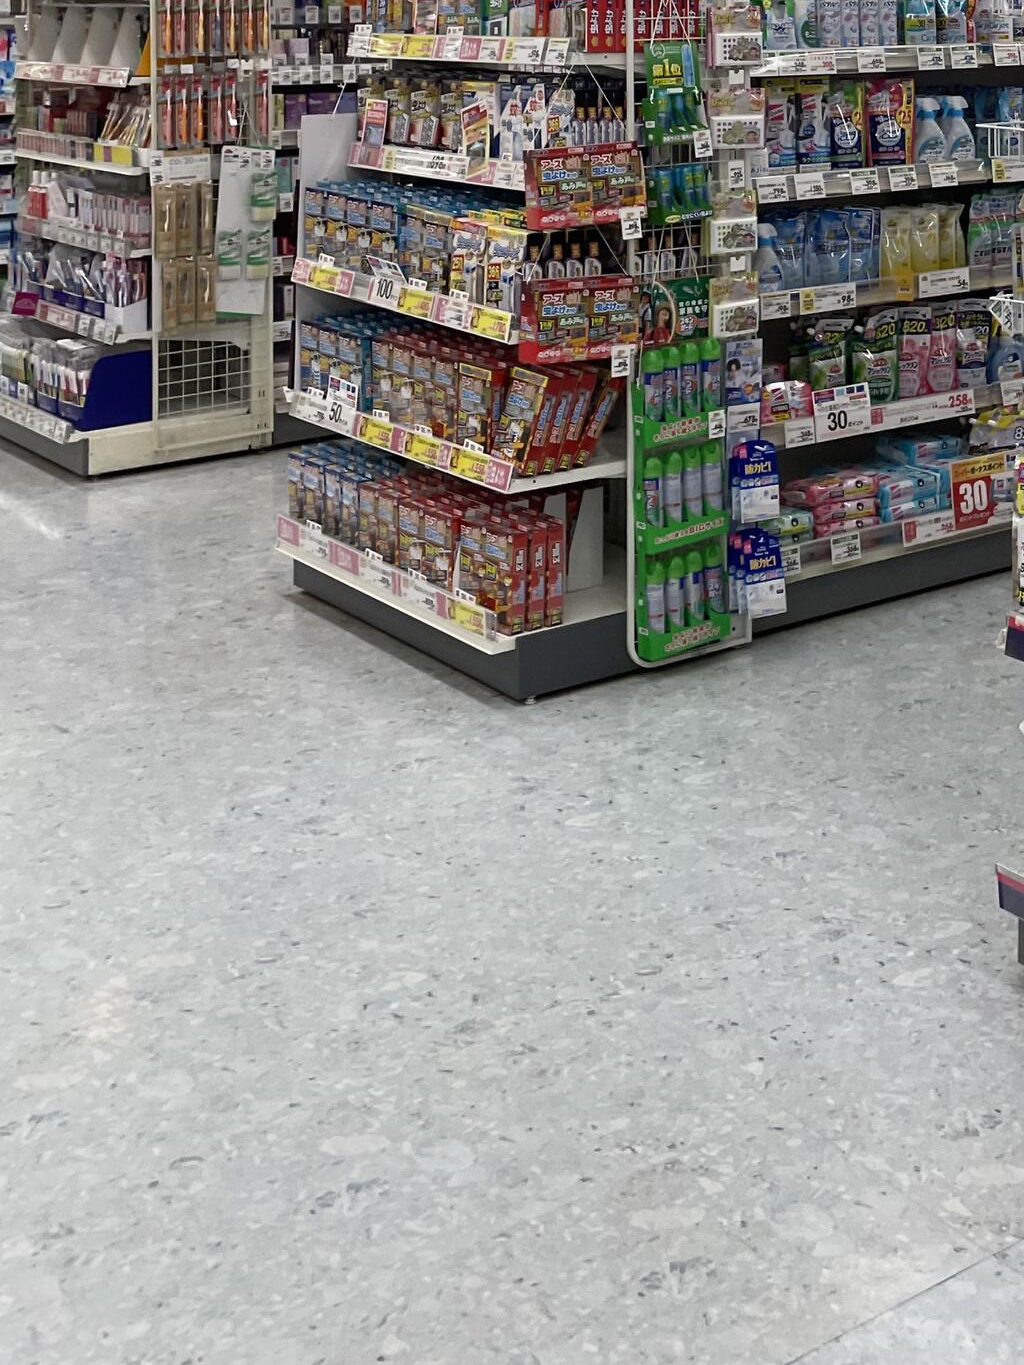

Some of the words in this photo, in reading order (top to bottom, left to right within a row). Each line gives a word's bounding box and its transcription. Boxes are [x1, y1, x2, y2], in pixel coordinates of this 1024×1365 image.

[541, 159, 563, 169] アース
[591, 154, 612, 164] アース
[543, 293, 564, 304] アース
[594, 290, 615, 301] アース
[959, 480, 988, 514] 30
